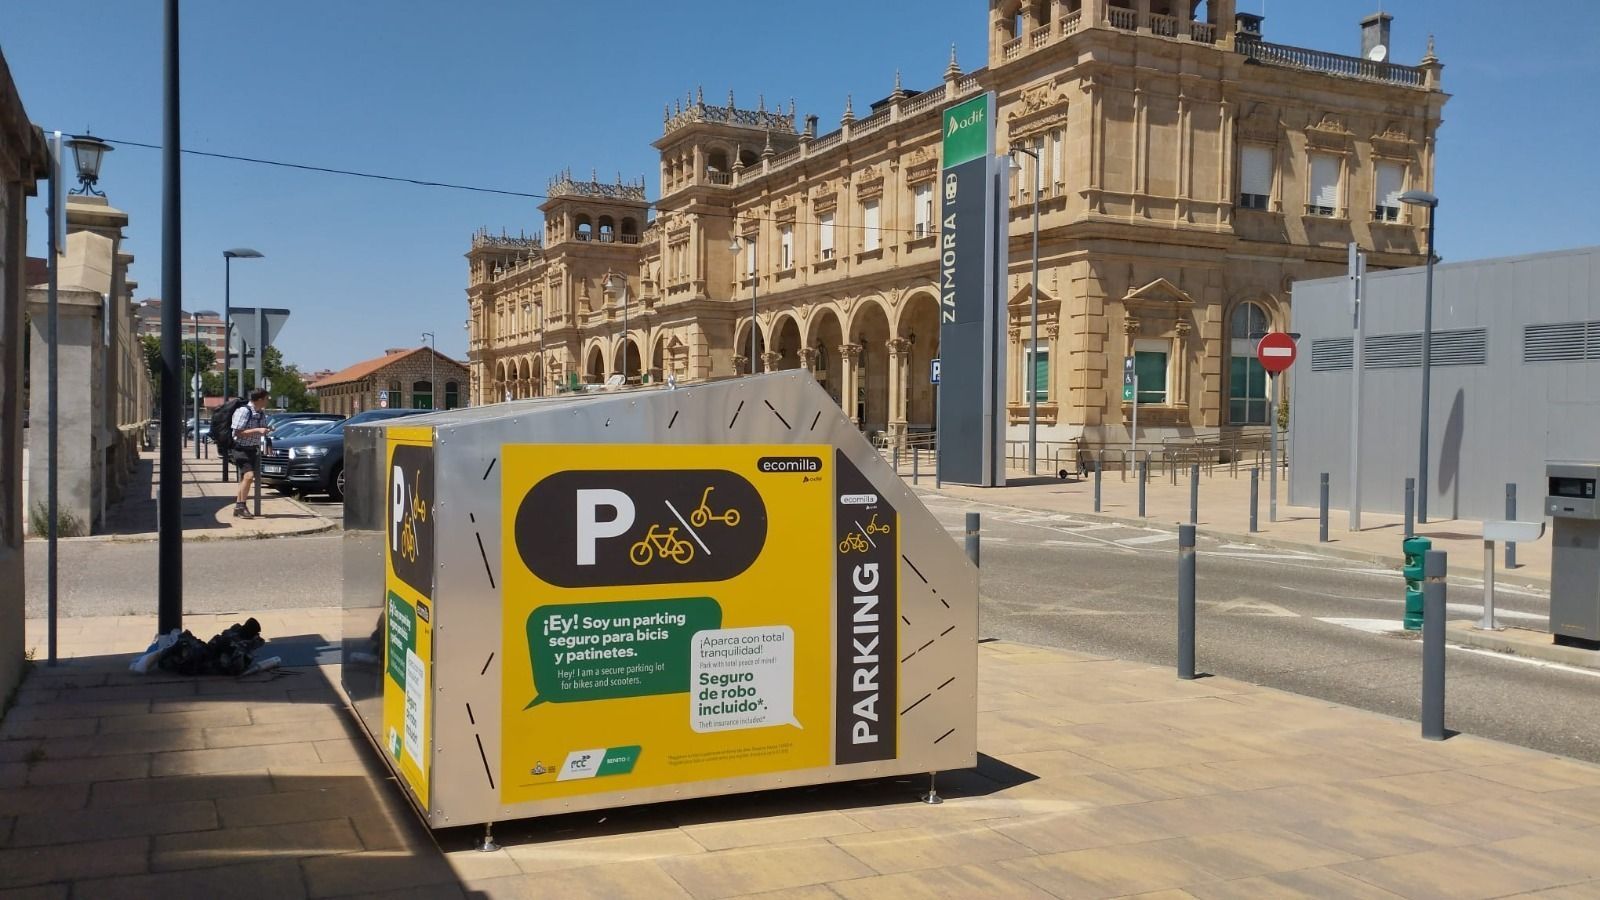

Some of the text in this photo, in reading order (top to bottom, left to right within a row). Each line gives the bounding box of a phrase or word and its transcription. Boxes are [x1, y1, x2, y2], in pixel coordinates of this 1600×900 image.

[959, 108, 984, 130] adif
[943, 212, 957, 323] ZAMORA
[763, 458, 817, 471] ecomilla
[393, 465, 405, 552] P
[843, 495, 874, 503] ecomilla
[576, 488, 636, 566] P
[543, 612, 686, 636] ¡Ey! Soy un parking
[549, 628, 669, 649] seguro para bicis
[700, 632, 785, 649] ¡Aparca con total
[554, 647, 638, 665] y patinetes.
[700, 644, 763, 659] tranquilidad!
[852, 562, 880, 745] PARKING
[557, 668, 576, 682] Hey!
[581, 669, 594, 677] am
[601, 667, 625, 676] secure
[626, 663, 654, 676] parking
[655, 662, 665, 671] lot
[699, 672, 754, 687] Seguro
[561, 676, 642, 690] for bikes and scooters.
[698, 685, 756, 701] de robo
